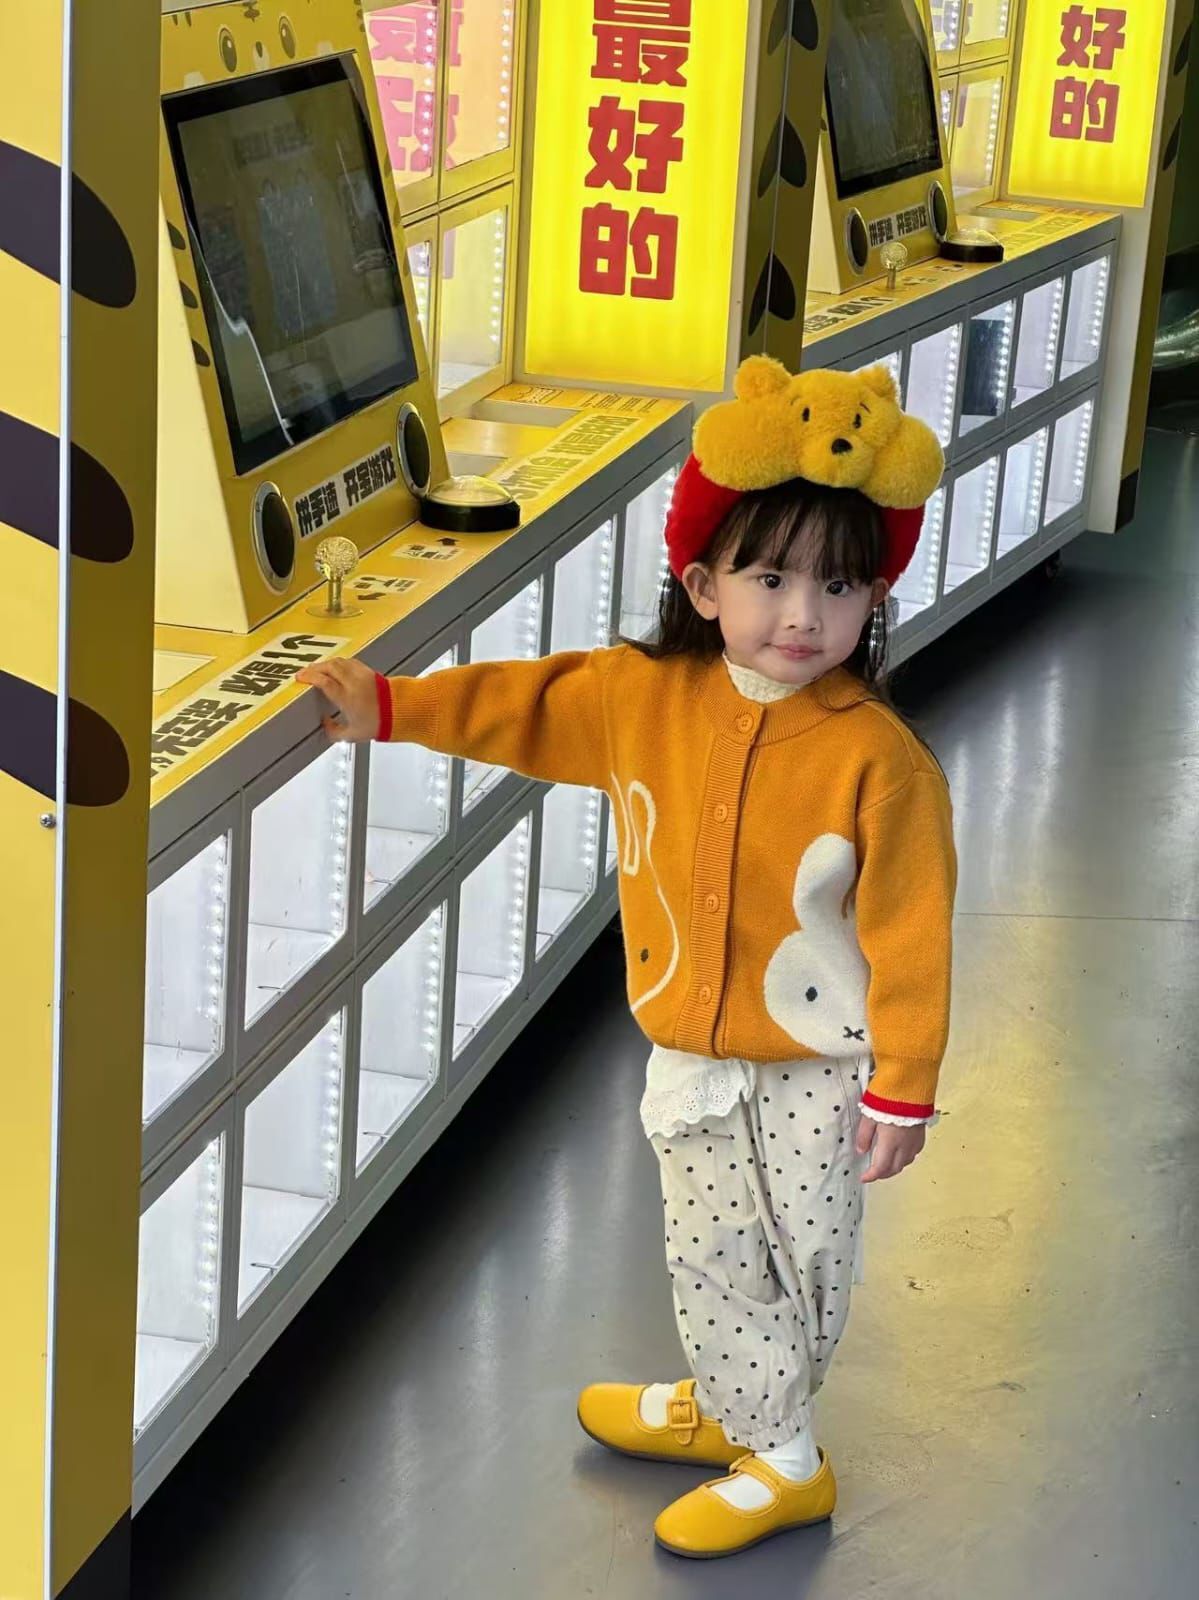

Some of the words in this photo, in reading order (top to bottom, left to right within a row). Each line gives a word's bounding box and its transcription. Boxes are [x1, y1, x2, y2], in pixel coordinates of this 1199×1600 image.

[579, 0, 691, 300] 最好的
[1049, 5, 1127, 143] 好的
